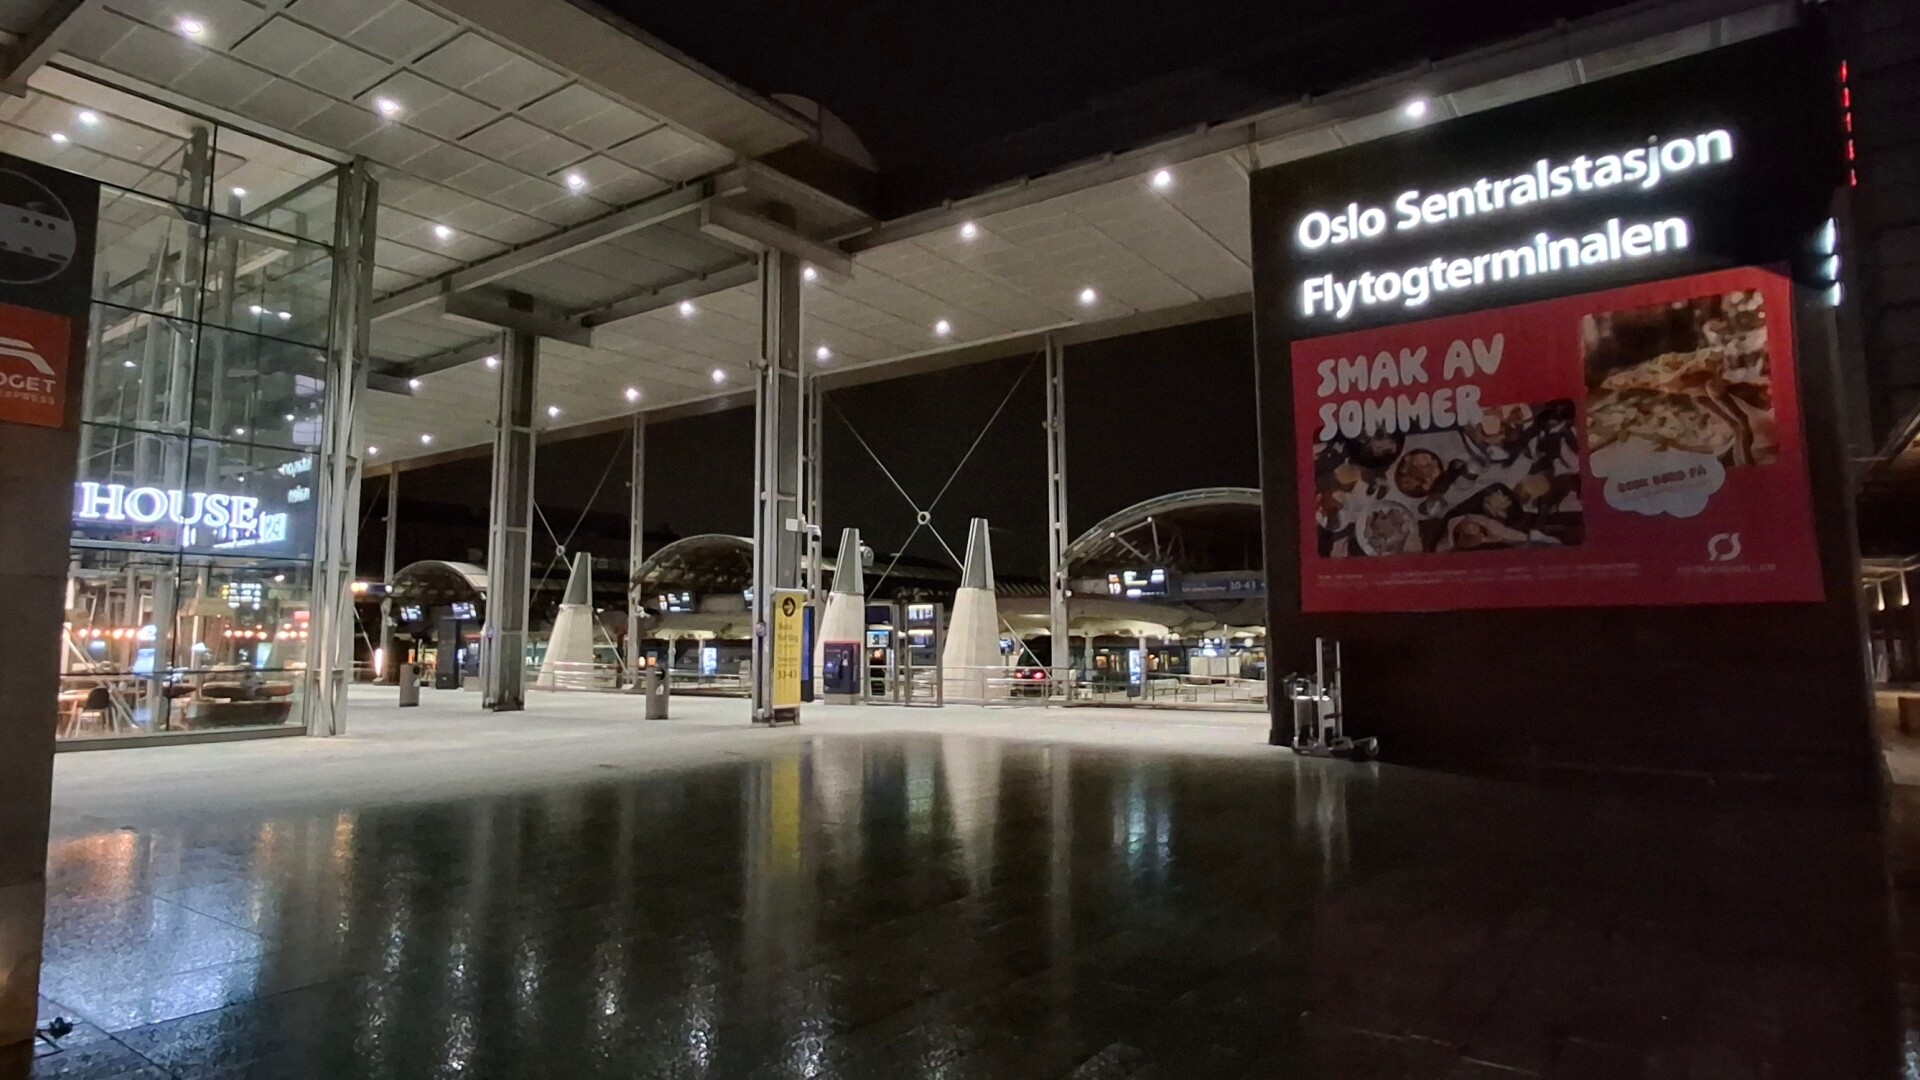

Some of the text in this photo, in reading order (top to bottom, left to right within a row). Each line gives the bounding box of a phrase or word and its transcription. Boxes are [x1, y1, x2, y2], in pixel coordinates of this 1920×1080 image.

[1296, 129, 1733, 251] Oslo Sentralstasjon
[1300, 217, 1690, 319] Flytogterminalen
[1317, 333, 1504, 397] SMAK AV
[1319, 385, 1484, 441] SOMMER
[80, 481, 259, 530] HOUSE
[1108, 583, 1121, 594] 19
